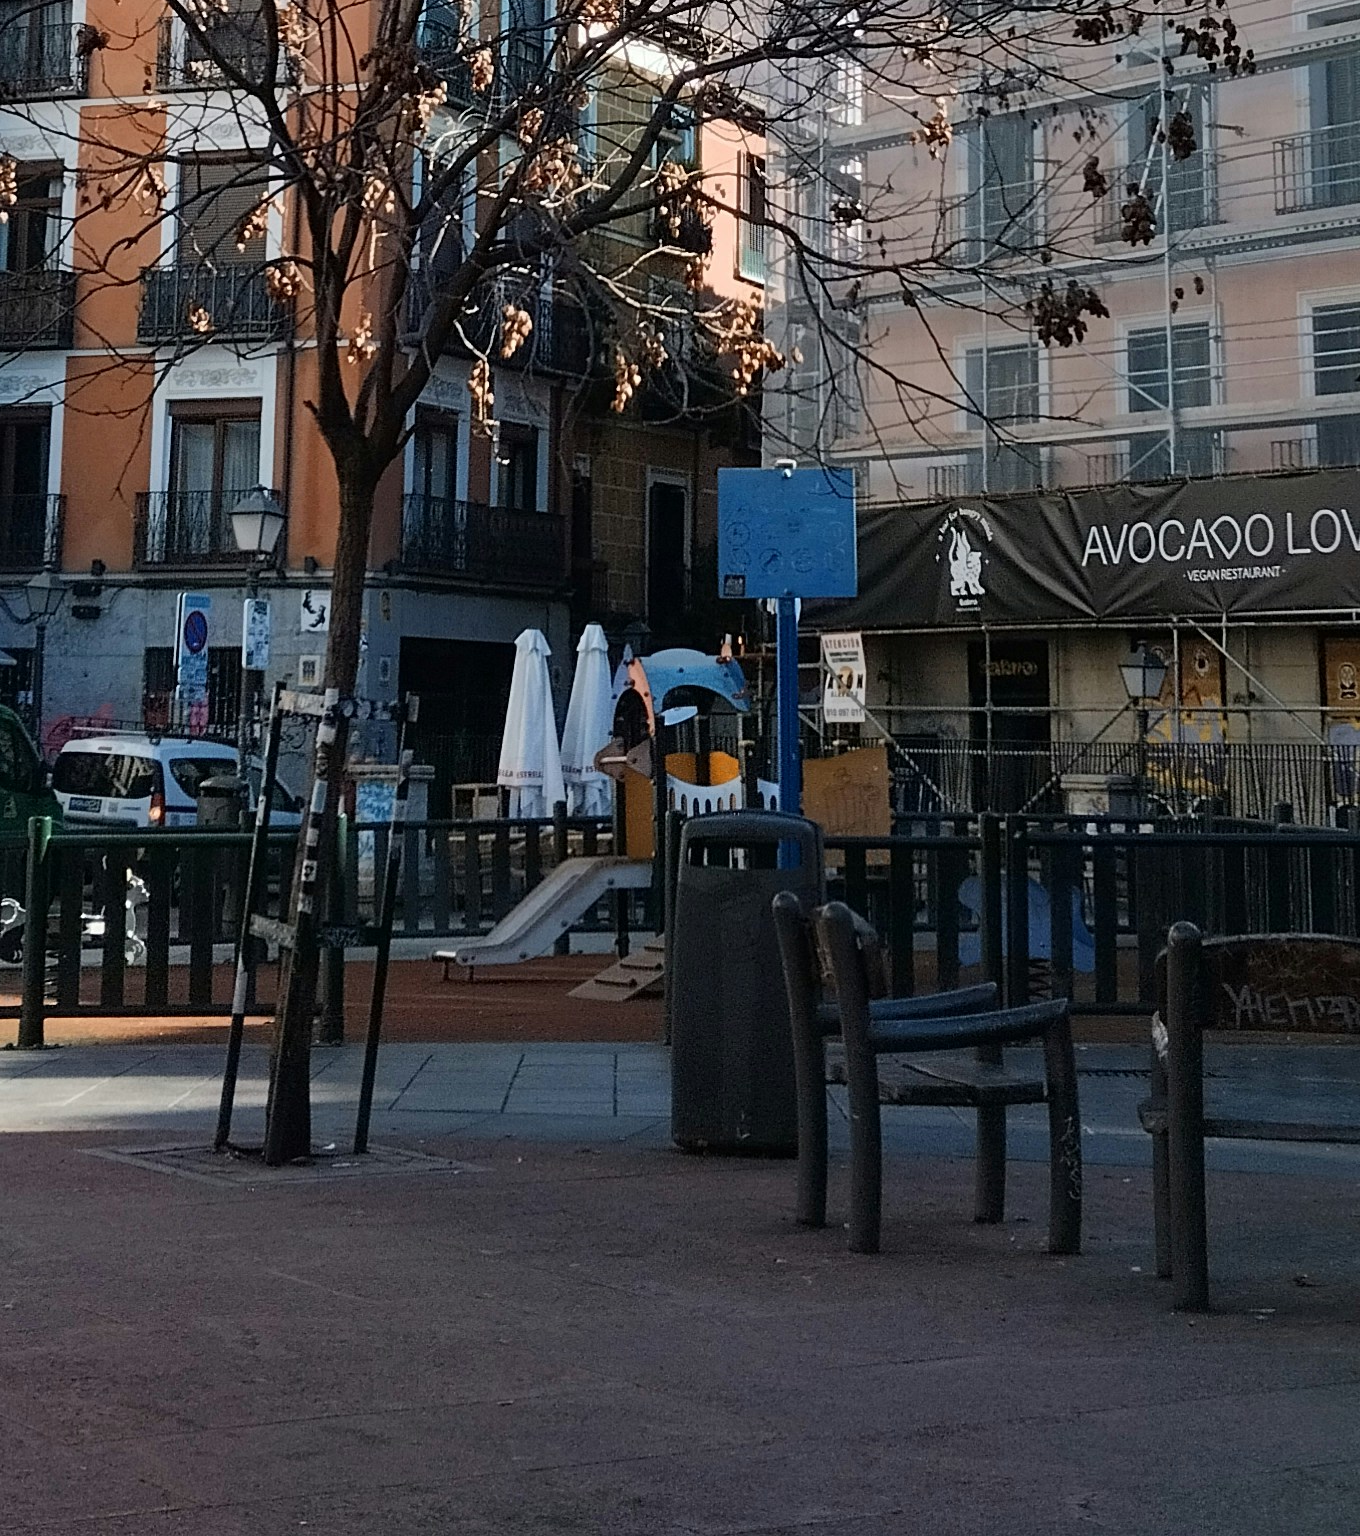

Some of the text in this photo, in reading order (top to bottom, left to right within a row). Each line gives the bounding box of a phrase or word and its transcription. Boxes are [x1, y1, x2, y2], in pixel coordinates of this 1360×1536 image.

[1082, 513, 1275, 567] AVOCADO
[1187, 566, 1282, 582] VEGAN RESTAURANT
